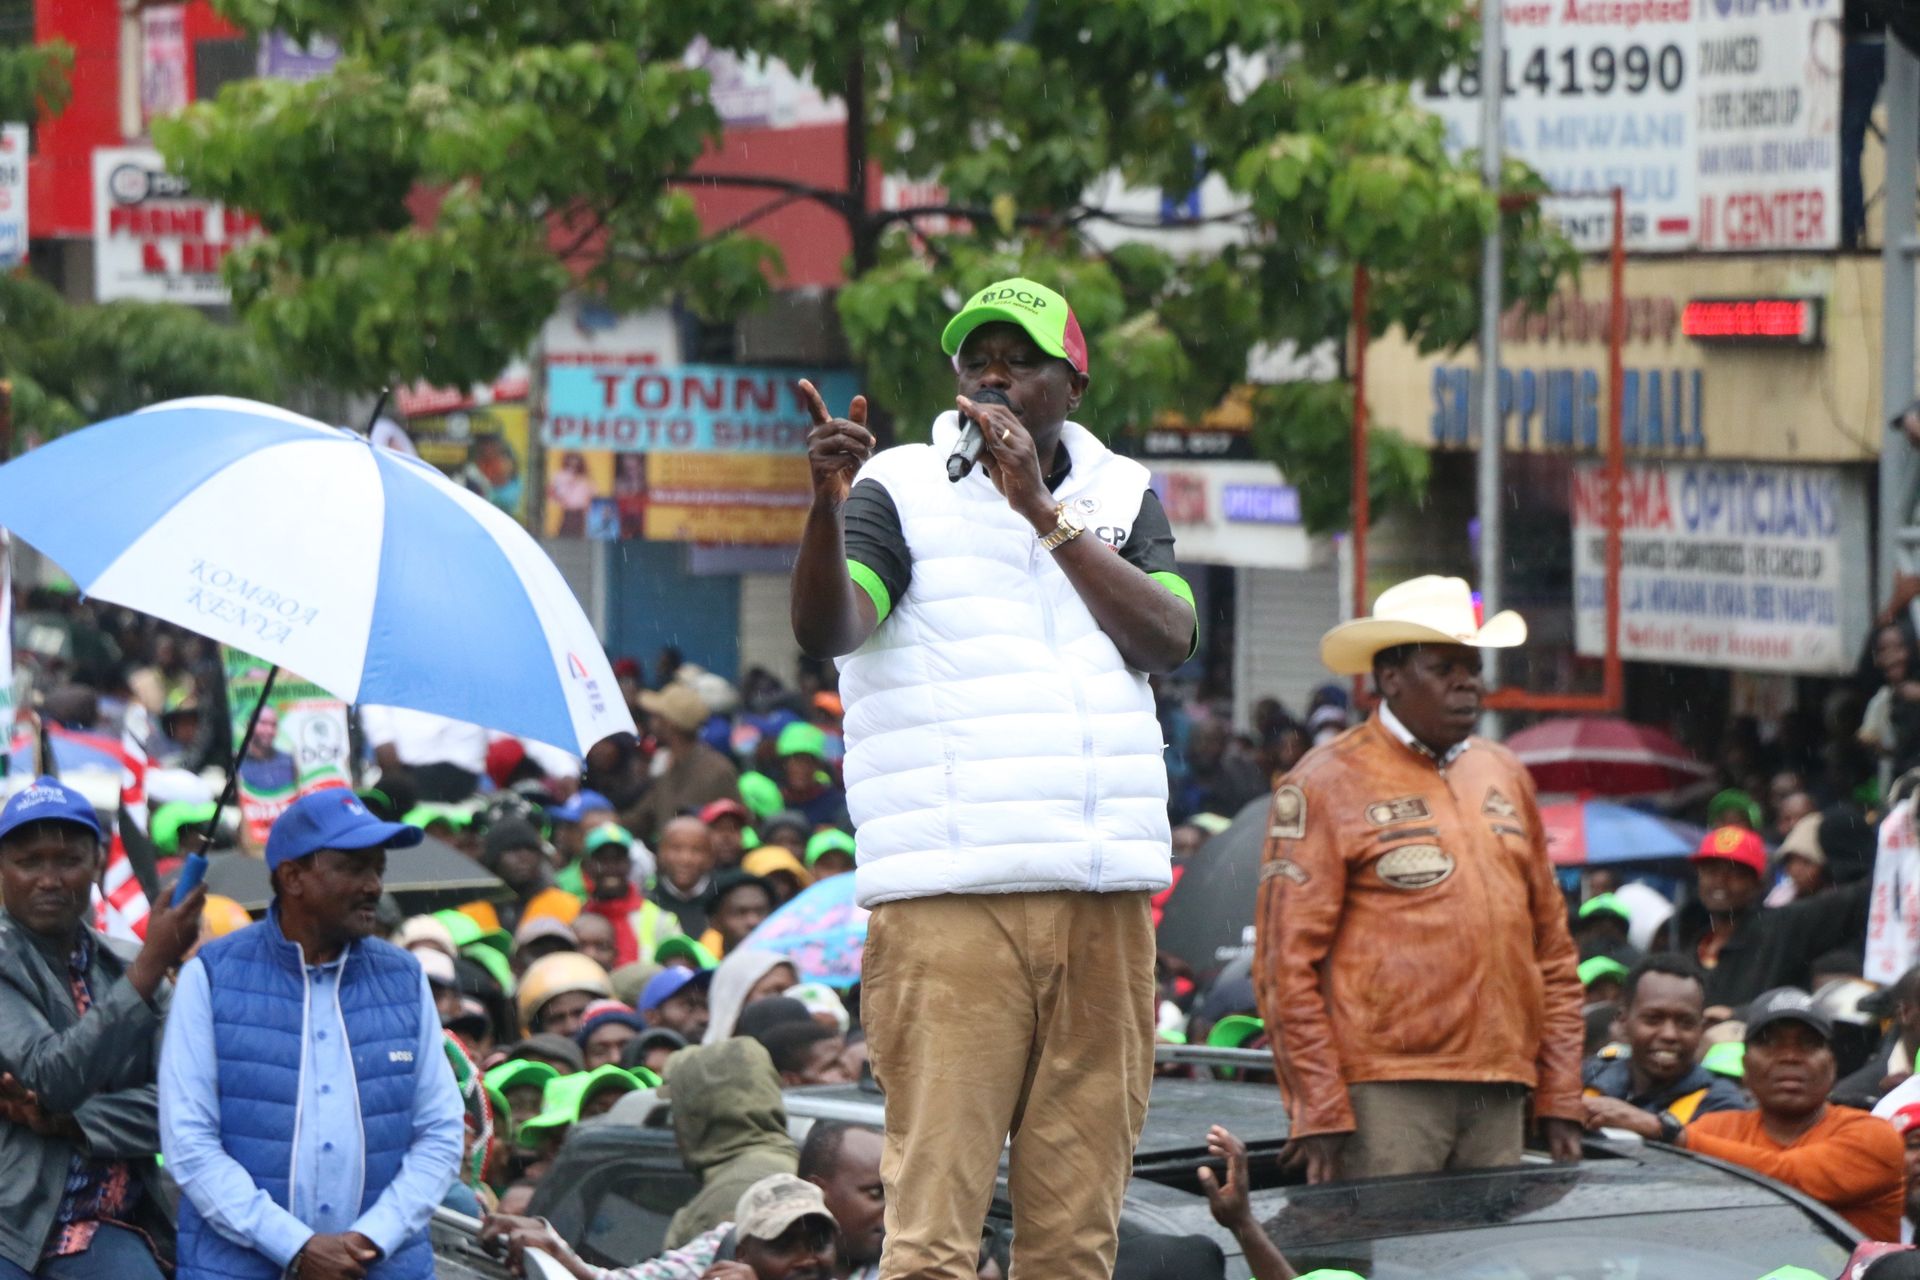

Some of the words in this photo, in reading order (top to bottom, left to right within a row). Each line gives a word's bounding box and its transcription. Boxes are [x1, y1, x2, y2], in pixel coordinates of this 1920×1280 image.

[1562, 0, 1690, 28] Accepted
[1539, 112, 1684, 148] MIWANI
[1723, 189, 1824, 244] CENTER
[998, 288, 1047, 308] DCP
[594, 373, 823, 412] TONNY
[1431, 365, 1598, 447] SHPPING
[552, 416, 692, 447] PHOTO
[1094, 526, 1126, 546] CP
[189, 558, 319, 626] KOMBOA
[187, 585, 292, 644] KENYA
